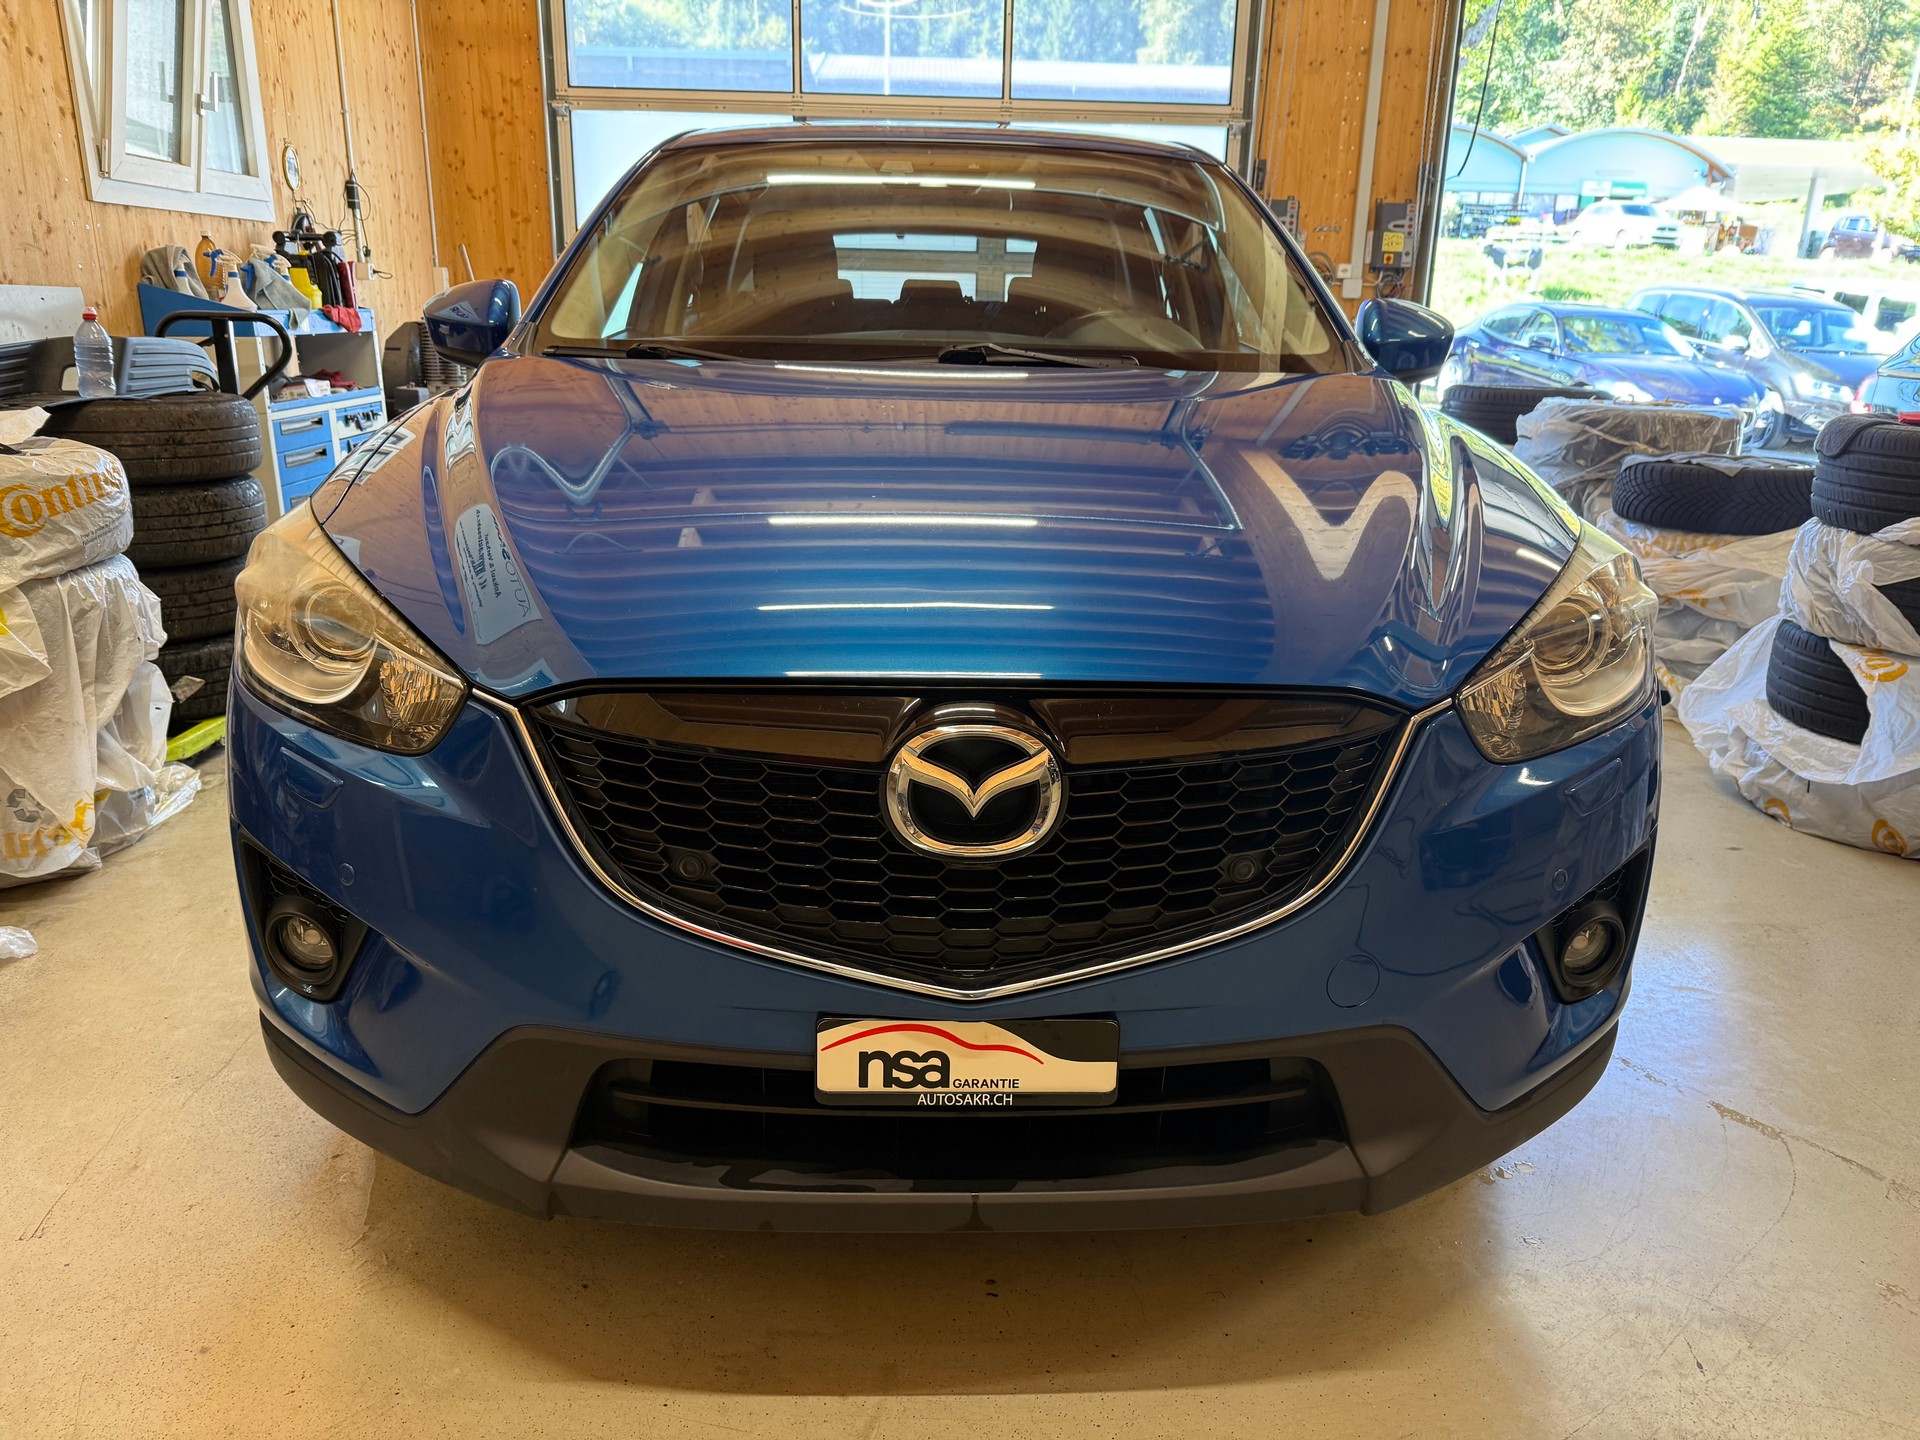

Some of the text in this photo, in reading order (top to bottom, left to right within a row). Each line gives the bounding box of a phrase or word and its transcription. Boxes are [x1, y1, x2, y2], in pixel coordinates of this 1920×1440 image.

[858, 1050, 1020, 1089] nsa GARANTIE
[917, 1093, 1013, 1106] AUTOSAKR.CH
